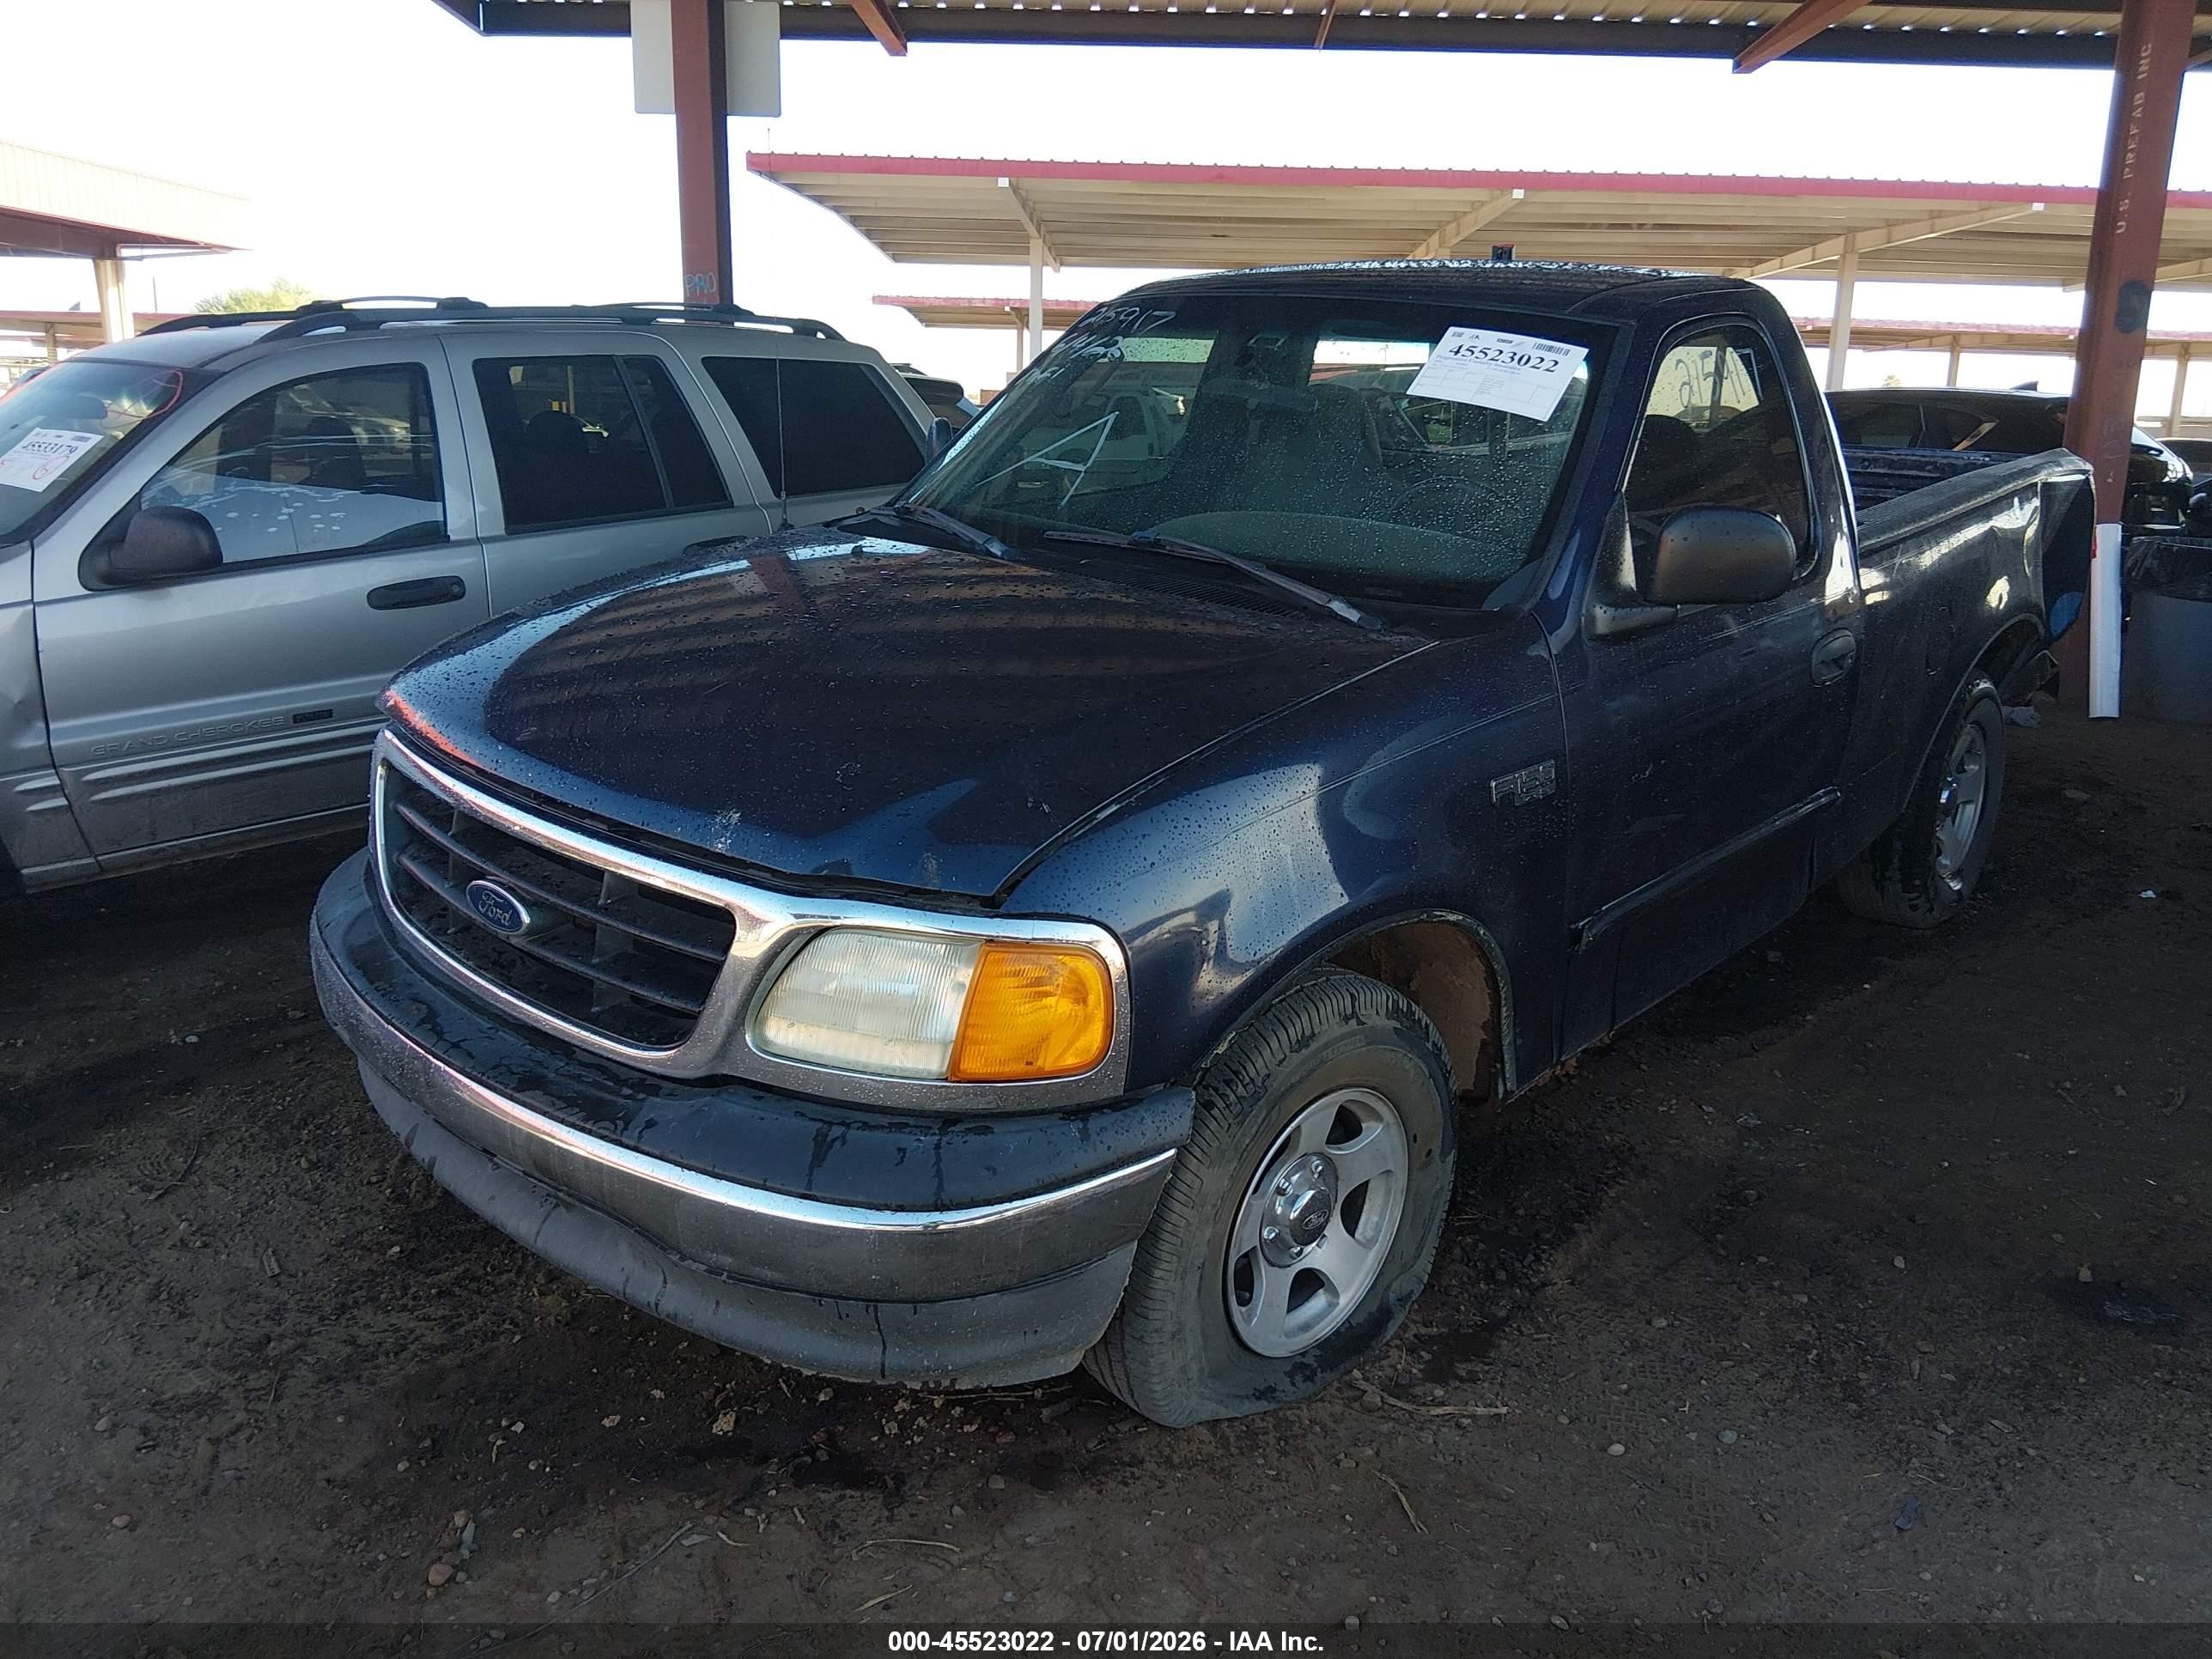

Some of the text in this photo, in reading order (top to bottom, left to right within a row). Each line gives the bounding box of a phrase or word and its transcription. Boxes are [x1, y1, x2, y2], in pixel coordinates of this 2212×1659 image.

[2123, 91, 2145, 179] PREFAB
[2136, 42, 2152, 80] INC
[1449, 343, 1559, 373] 45523022
[90, 734, 168, 757] GRAND
[173, 715, 286, 743] CHEROKEE
[478, 890, 513, 926] Ford
